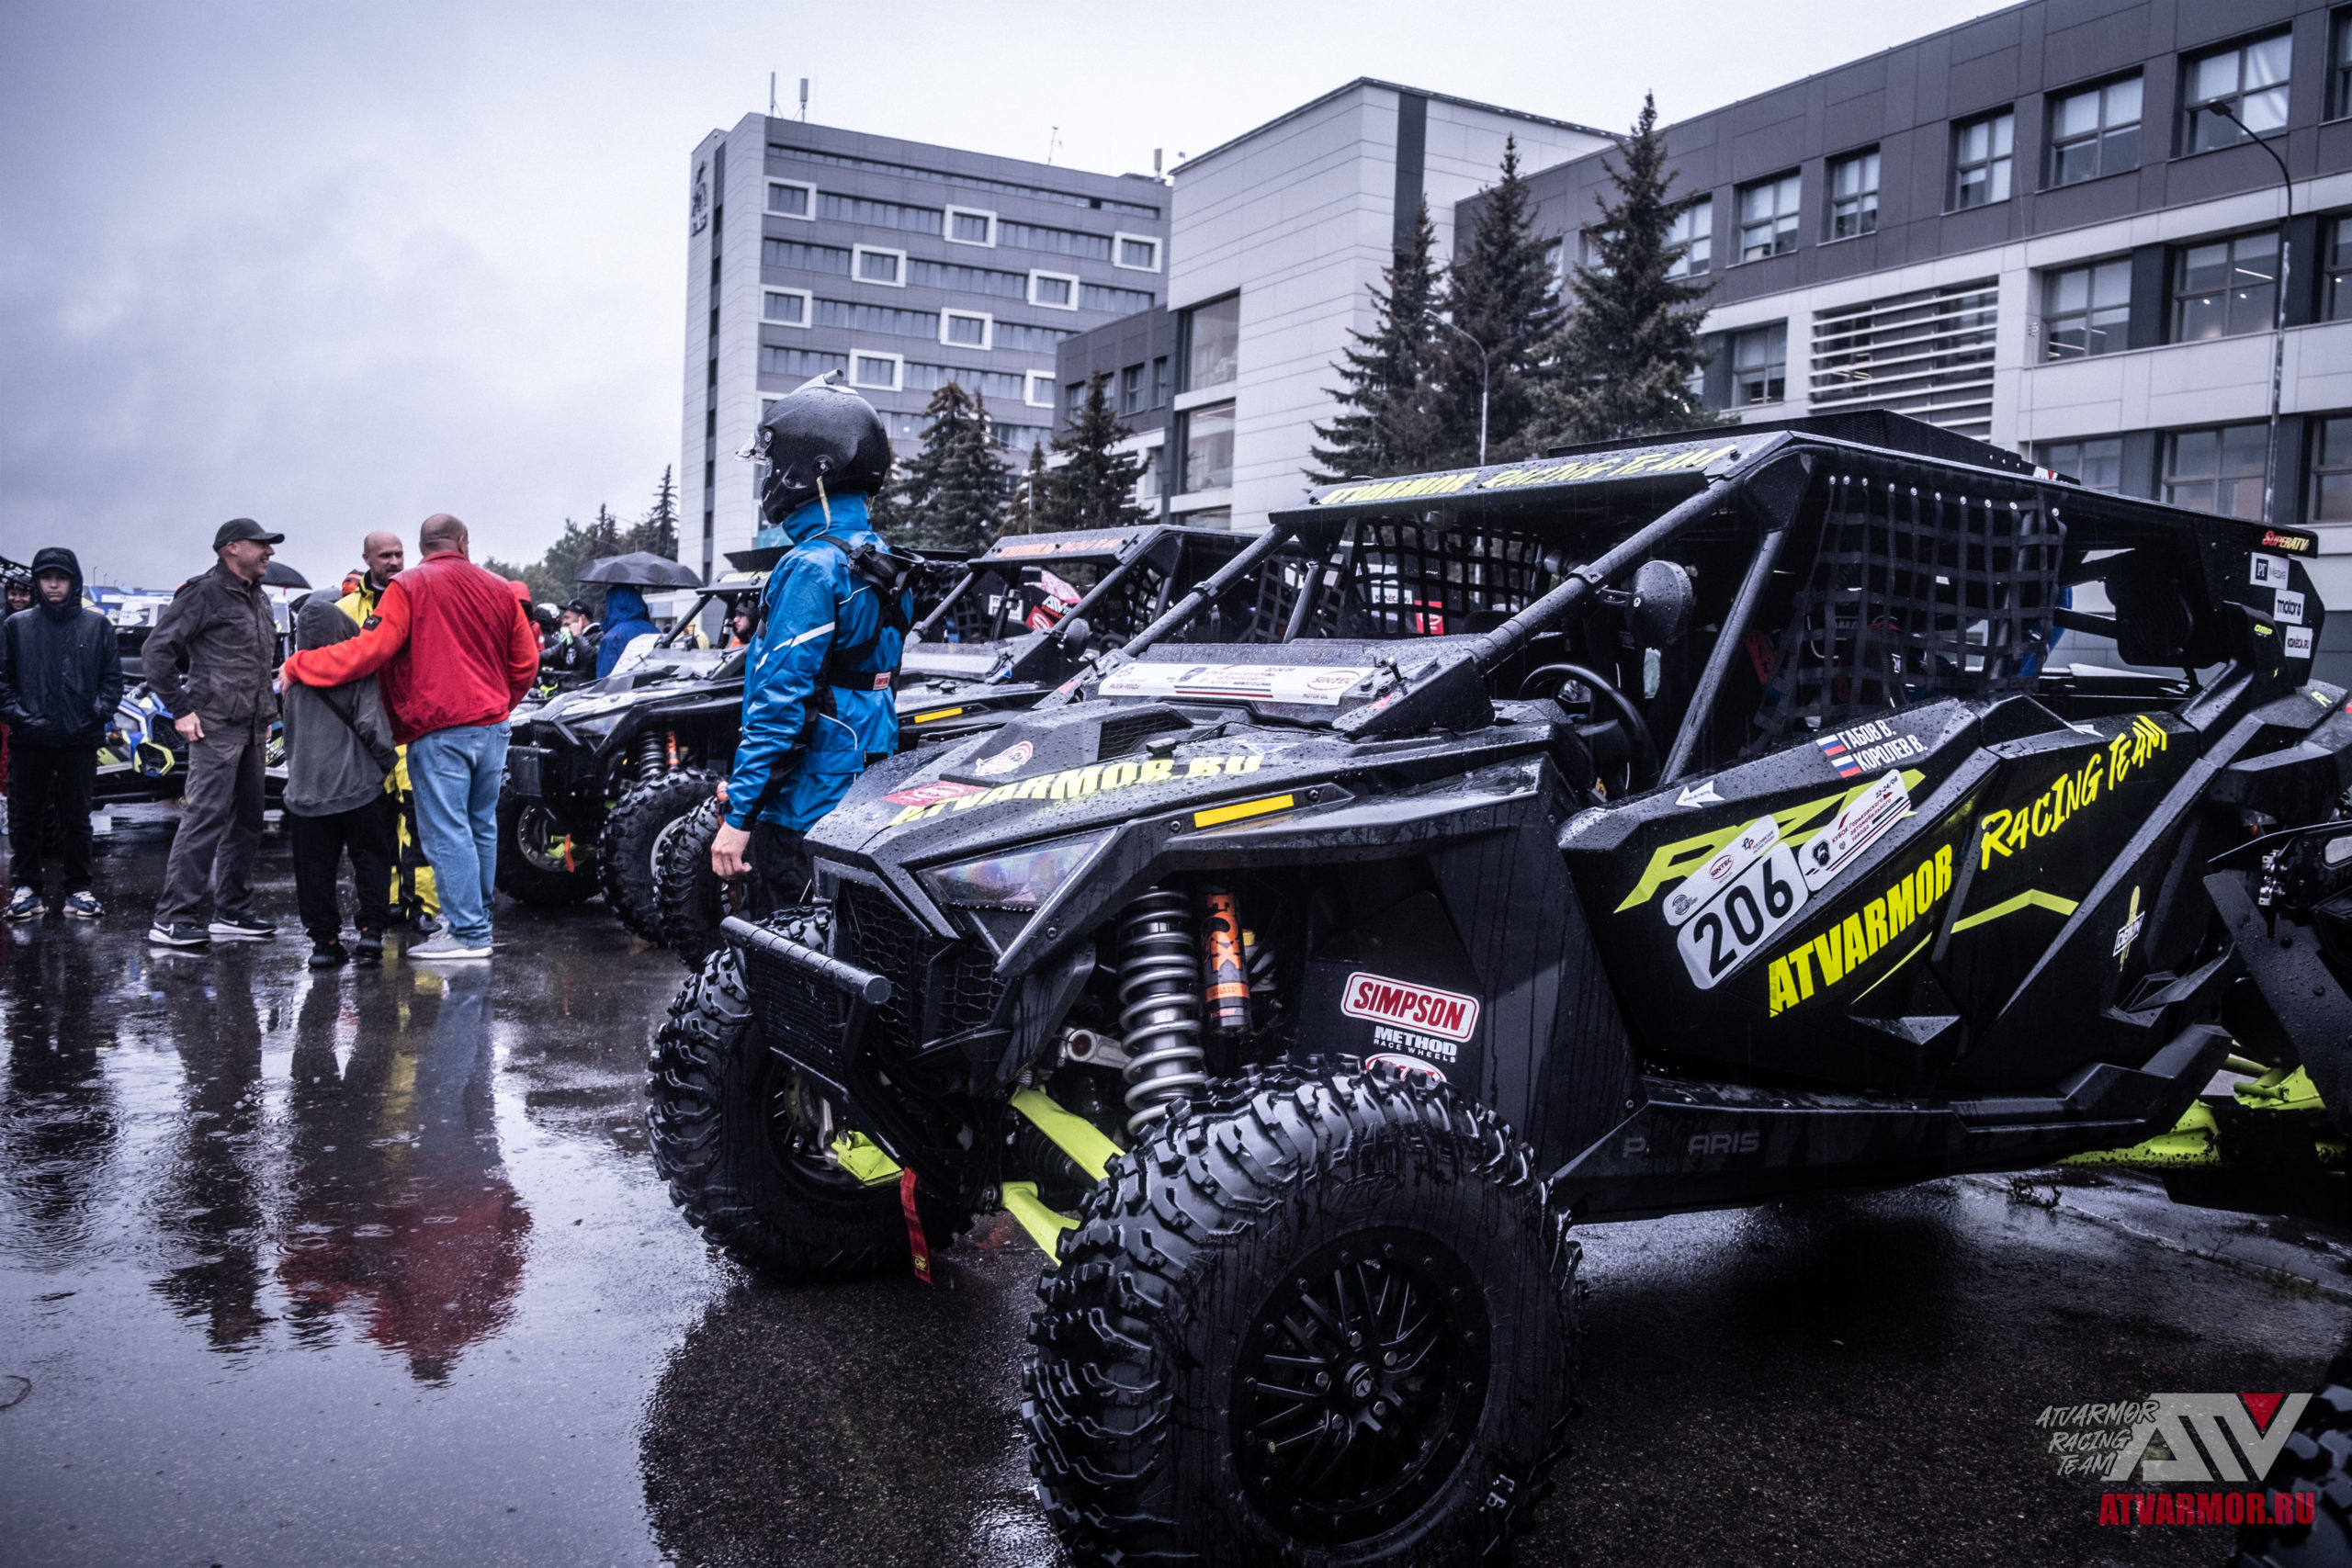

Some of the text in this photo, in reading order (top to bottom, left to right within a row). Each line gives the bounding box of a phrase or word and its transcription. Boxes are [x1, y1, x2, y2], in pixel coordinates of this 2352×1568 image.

[1838, 723, 1883, 750] ГАБОВ
[1852, 738, 1915, 772] КОРОЛЕВ
[1981, 715, 2167, 871] RACING TEAM
[1711, 857, 1733, 878] SINTEC
[1693, 857, 1793, 978] 206
[1769, 844, 1952, 1018] ATVARMOR
[1353, 981, 1466, 1031] SIMPSON
[1374, 1025, 1458, 1056] METHOD
[1374, 1038, 1456, 1063] RACE WHEELS
